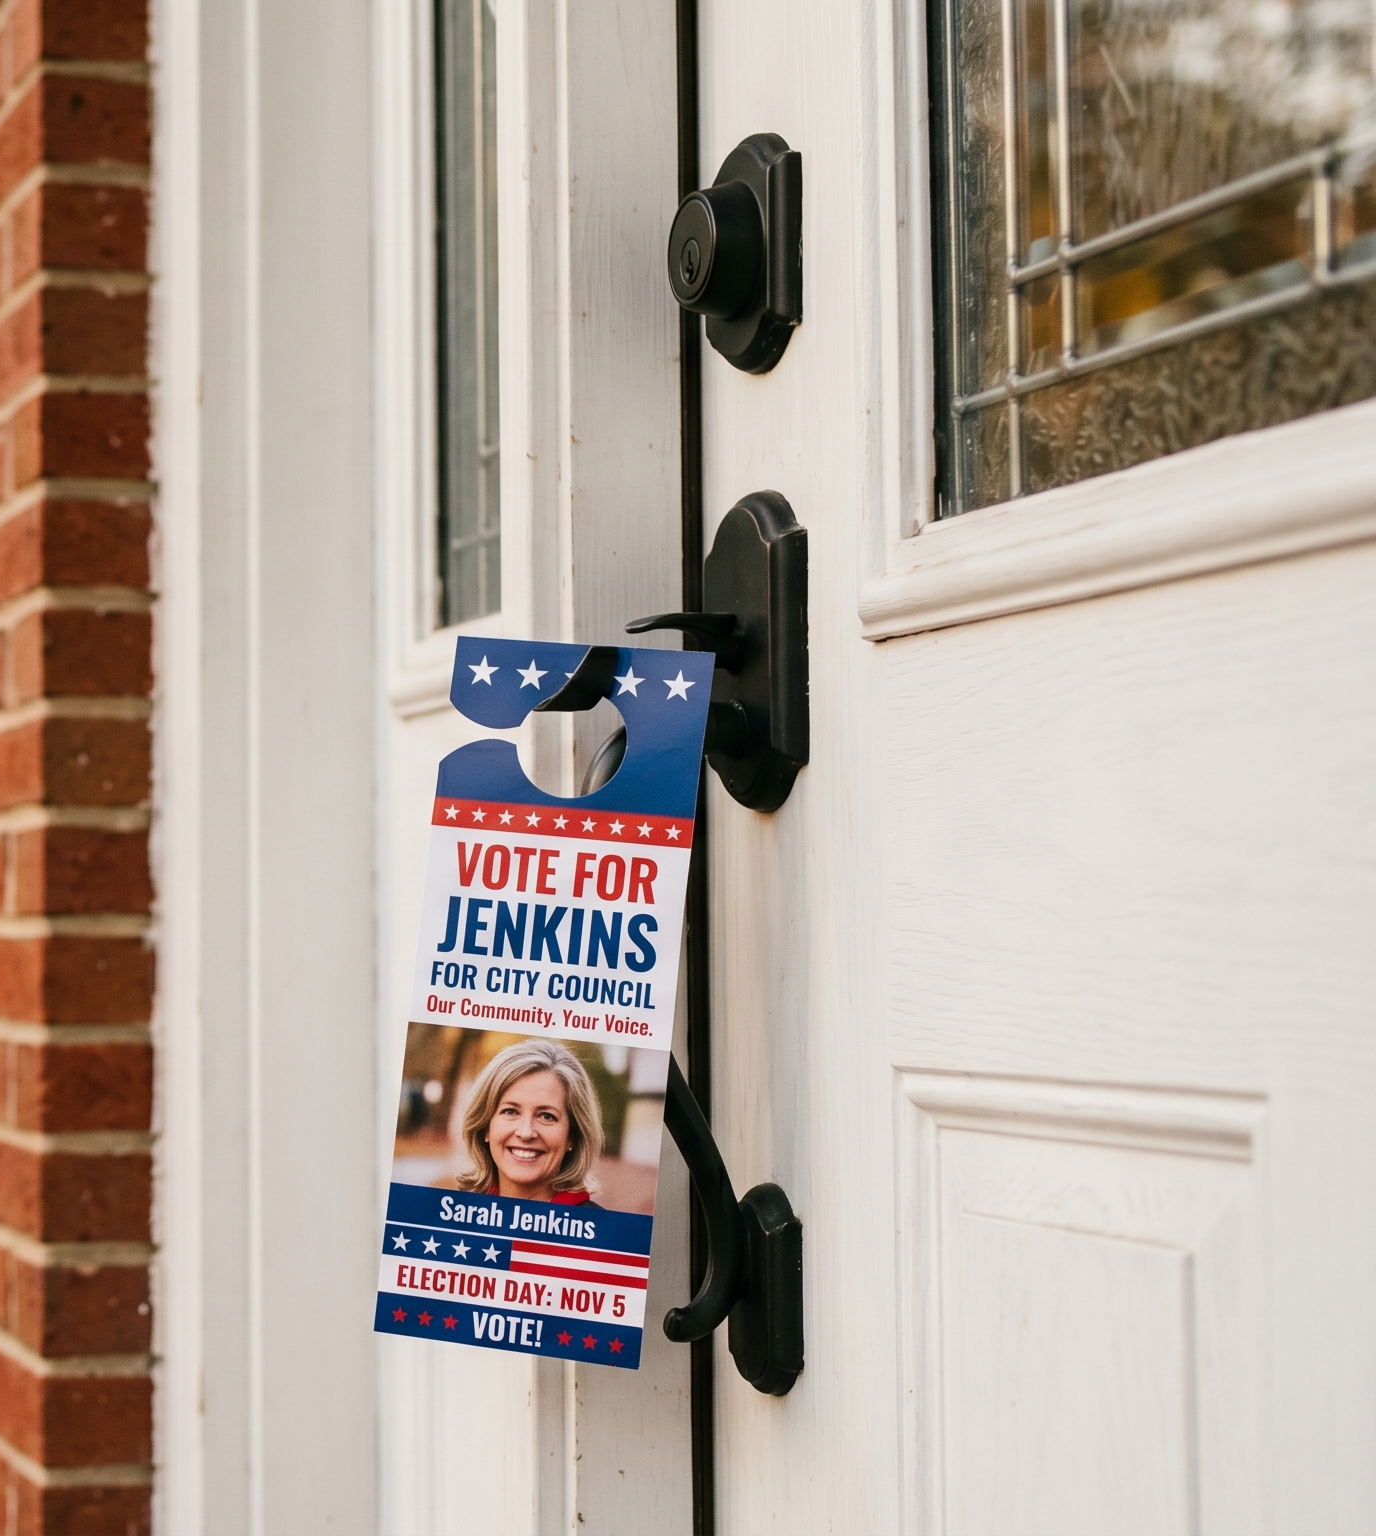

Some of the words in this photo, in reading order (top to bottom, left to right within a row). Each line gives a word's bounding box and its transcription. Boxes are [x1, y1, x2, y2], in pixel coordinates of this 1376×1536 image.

[456, 842, 560, 895] VOTE
[573, 852, 658, 904] FOR
[437, 896, 658, 972] JENKINS
[431, 961, 478, 990] FOR
[486, 967, 540, 996] CITY
[548, 974, 655, 1009] COUNCIL
[426, 995, 455, 1015] Our
[460, 998, 556, 1028] Community.
[563, 1010, 599, 1030] Your
[605, 1014, 652, 1036] Voice.
[440, 1196, 503, 1227] Sarah
[510, 1202, 595, 1239] Jenkins
[396, 1264, 496, 1299] ELECTION
[504, 1278, 552, 1307] DAY:
[561, 1287, 605, 1314] NOV
[613, 1295, 625, 1317] 5
[473, 1311, 542, 1347] VOTE!
